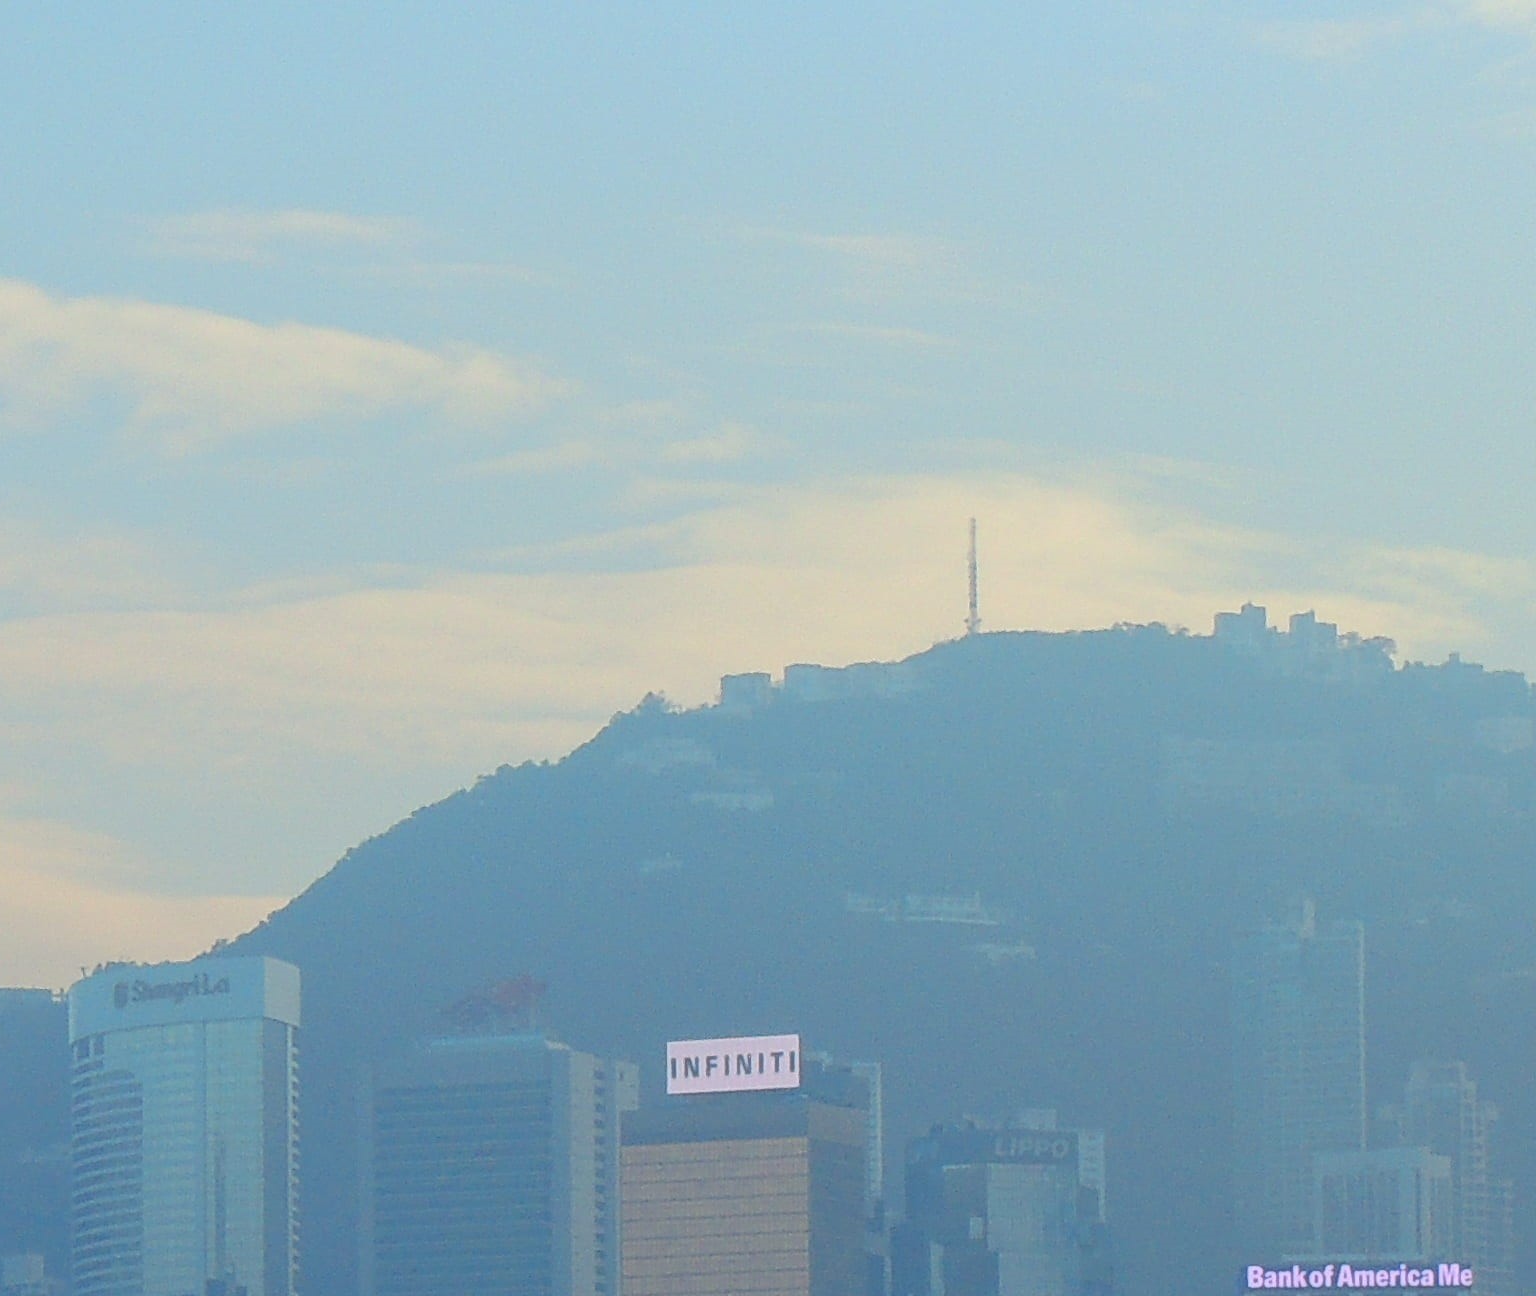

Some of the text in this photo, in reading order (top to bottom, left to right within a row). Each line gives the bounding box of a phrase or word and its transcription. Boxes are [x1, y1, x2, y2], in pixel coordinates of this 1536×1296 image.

[670, 1050, 796, 1079] INFINITI
[994, 1135, 1069, 1158] LIPPO
[1247, 1265, 1308, 1288] Bank
[1309, 1264, 1335, 1288] of
[1337, 1264, 1434, 1287] America
